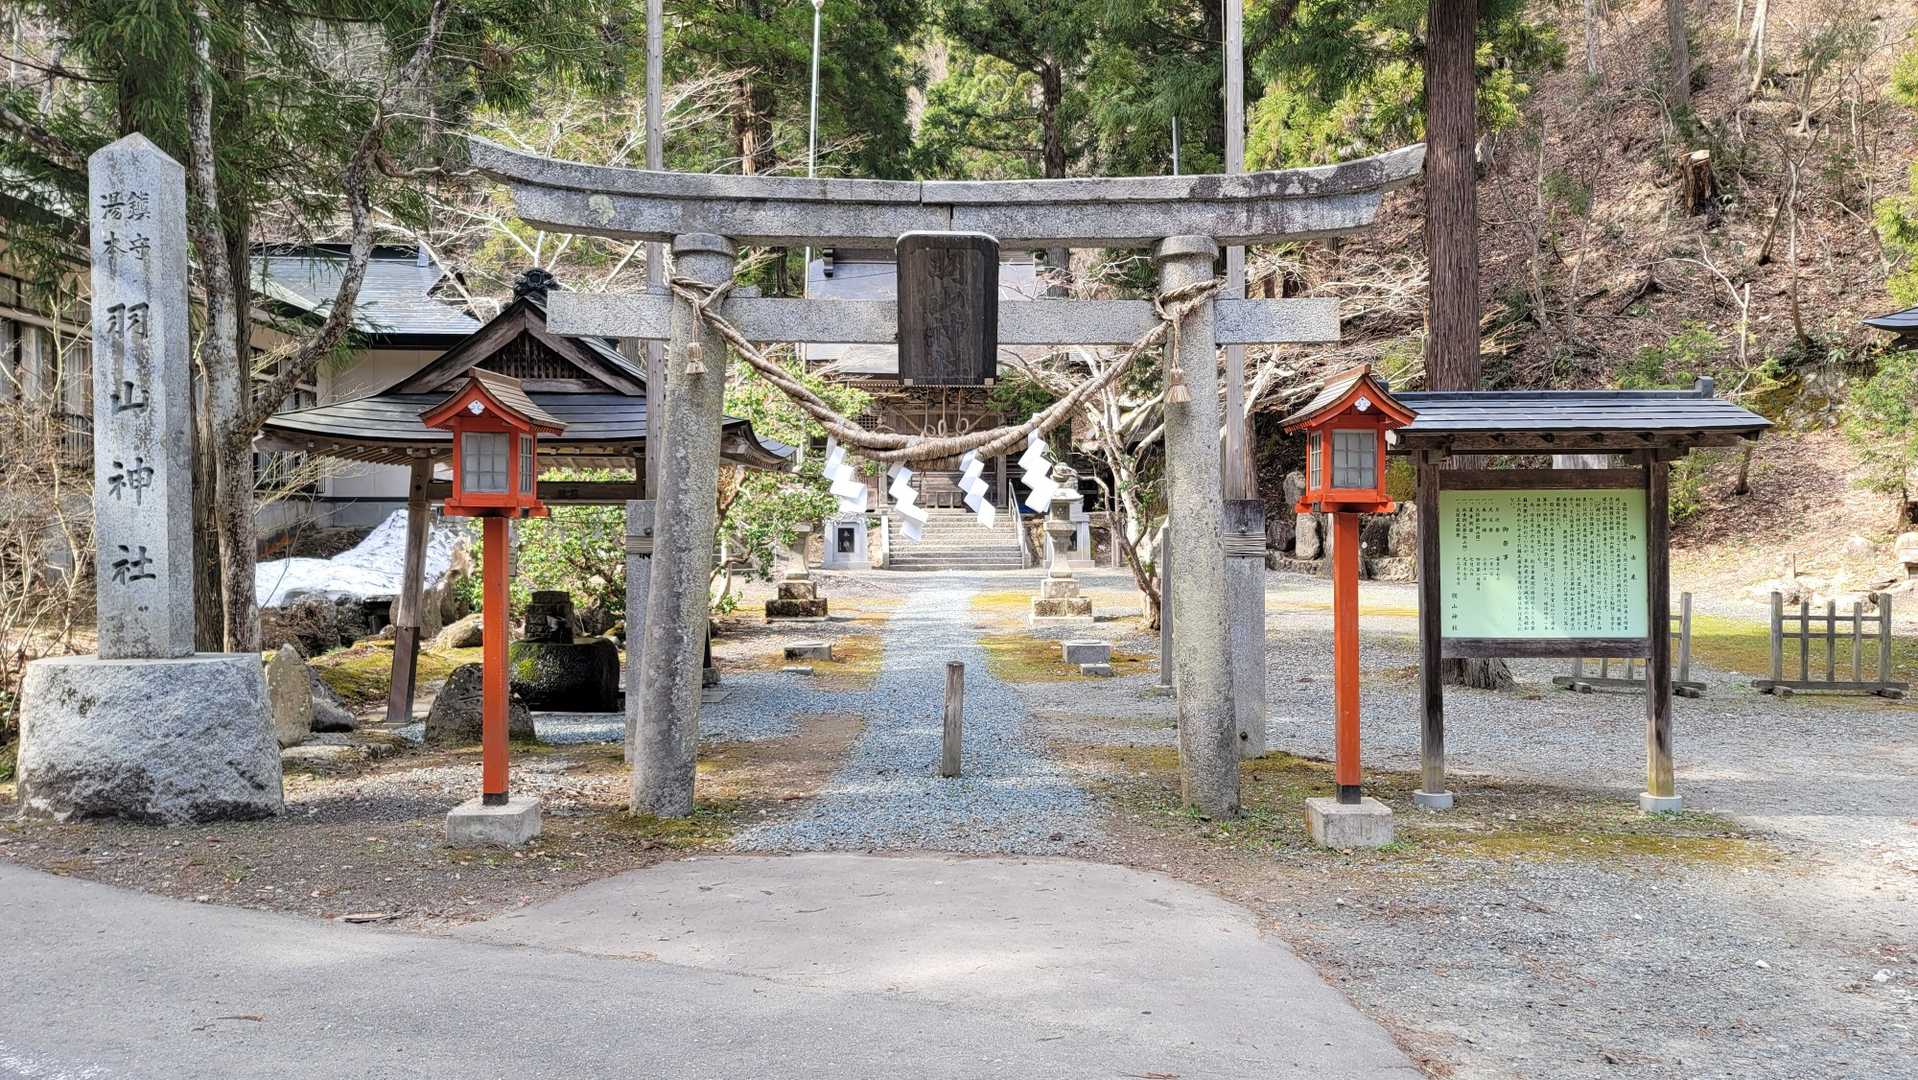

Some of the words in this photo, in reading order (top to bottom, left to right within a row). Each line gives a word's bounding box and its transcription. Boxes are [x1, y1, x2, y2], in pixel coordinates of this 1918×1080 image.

[100, 191, 128, 263] 湯本
[106, 302, 156, 586] 羽山神社
